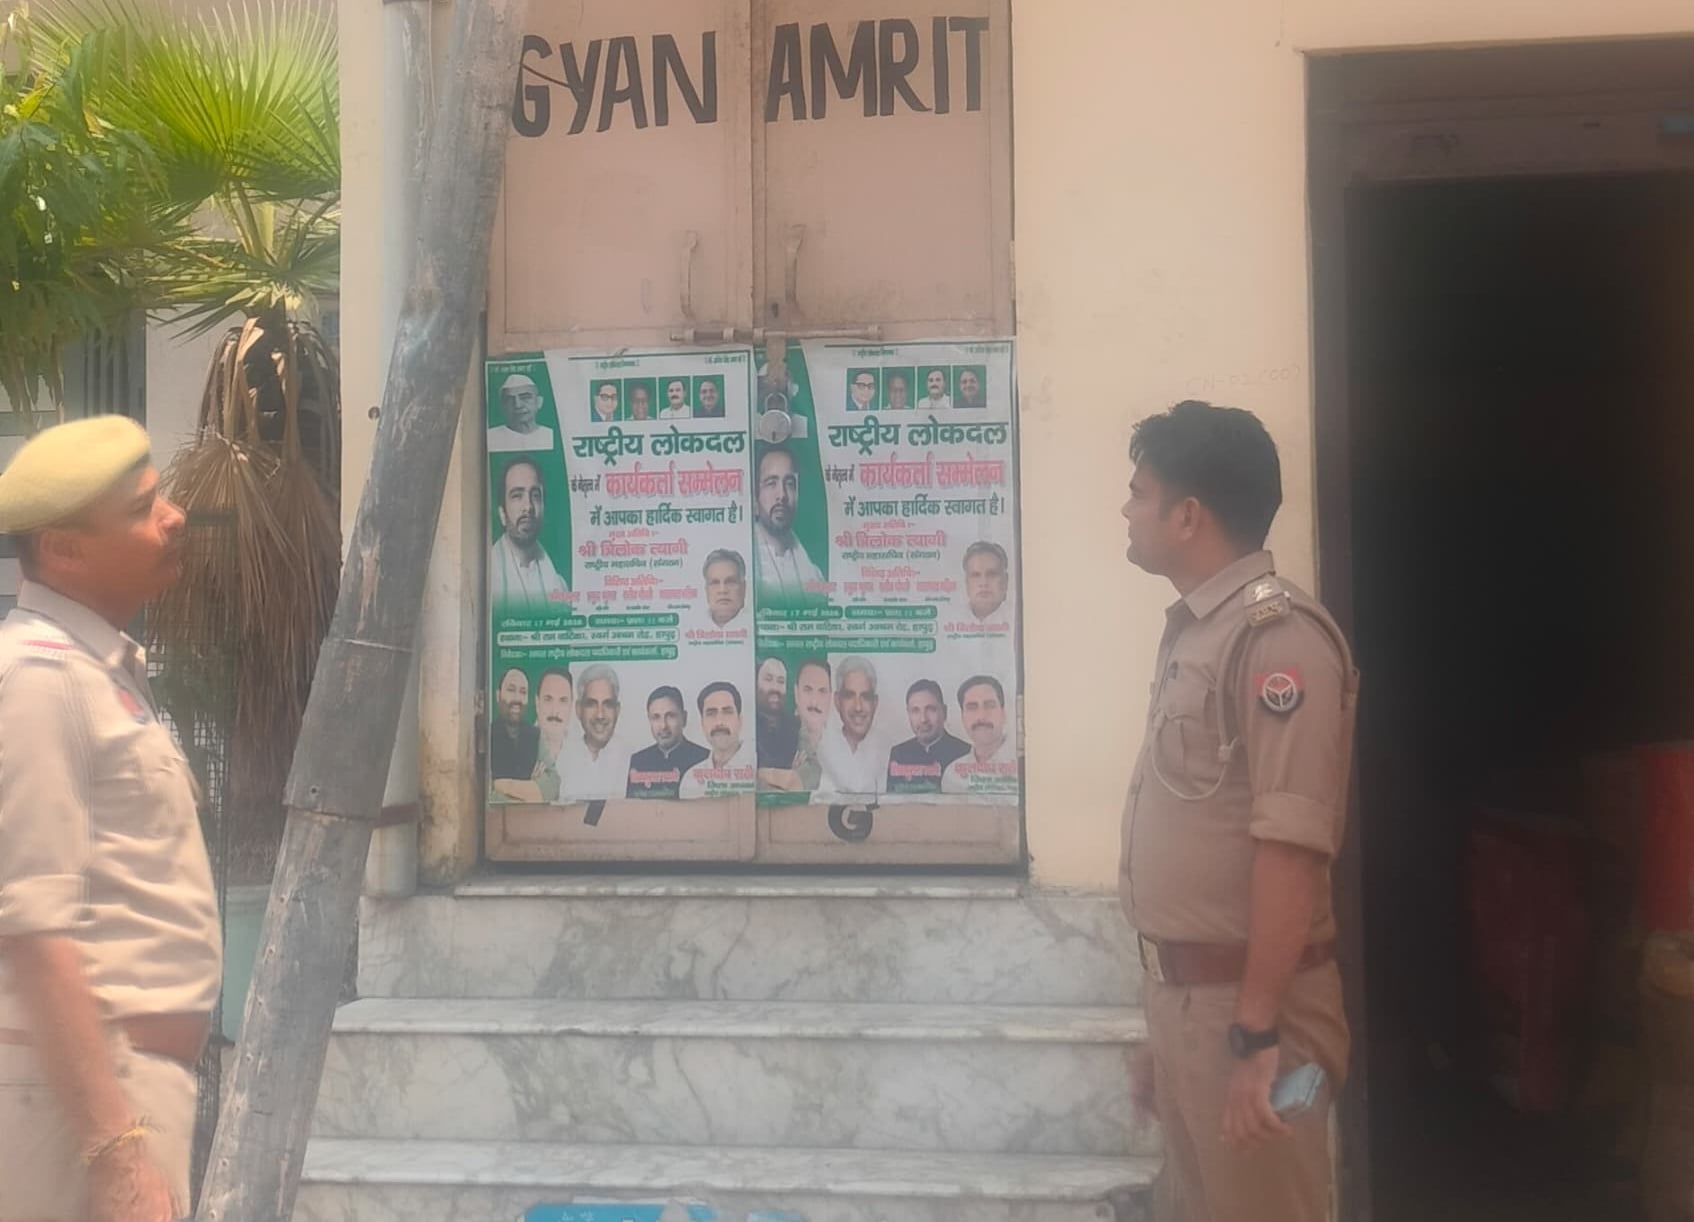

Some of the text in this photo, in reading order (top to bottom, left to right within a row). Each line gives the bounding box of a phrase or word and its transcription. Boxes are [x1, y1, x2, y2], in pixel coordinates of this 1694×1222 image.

[511, 31, 717, 137] GYAN
[765, 16, 989, 122] AMRIT
[571, 424, 747, 466] राष्ट्रीय लोकदल
[828, 414, 1009, 455] राष्ट्रीय लोकदल
[605, 460, 674, 497] कार्यकर्ता
[677, 460, 744, 497] सम्मेलन
[859, 451, 932, 487] कार्यकर्ता
[936, 451, 1005, 486] सम्मेलन
[590, 505, 602, 526] में
[603, 509, 643, 526] आपका
[646, 503, 683, 526] हार्दिक
[685, 507, 725, 524] स्वागत
[844, 496, 856, 517] में
[857, 499, 898, 517] आपका
[902, 493, 941, 517] हार्दिक
[944, 499, 986, 516] स्वागत
[578, 538, 688, 558] श्री त्रिलोक त्यागी
[835, 530, 946, 549] श्री त्रिलोक त्यागी
